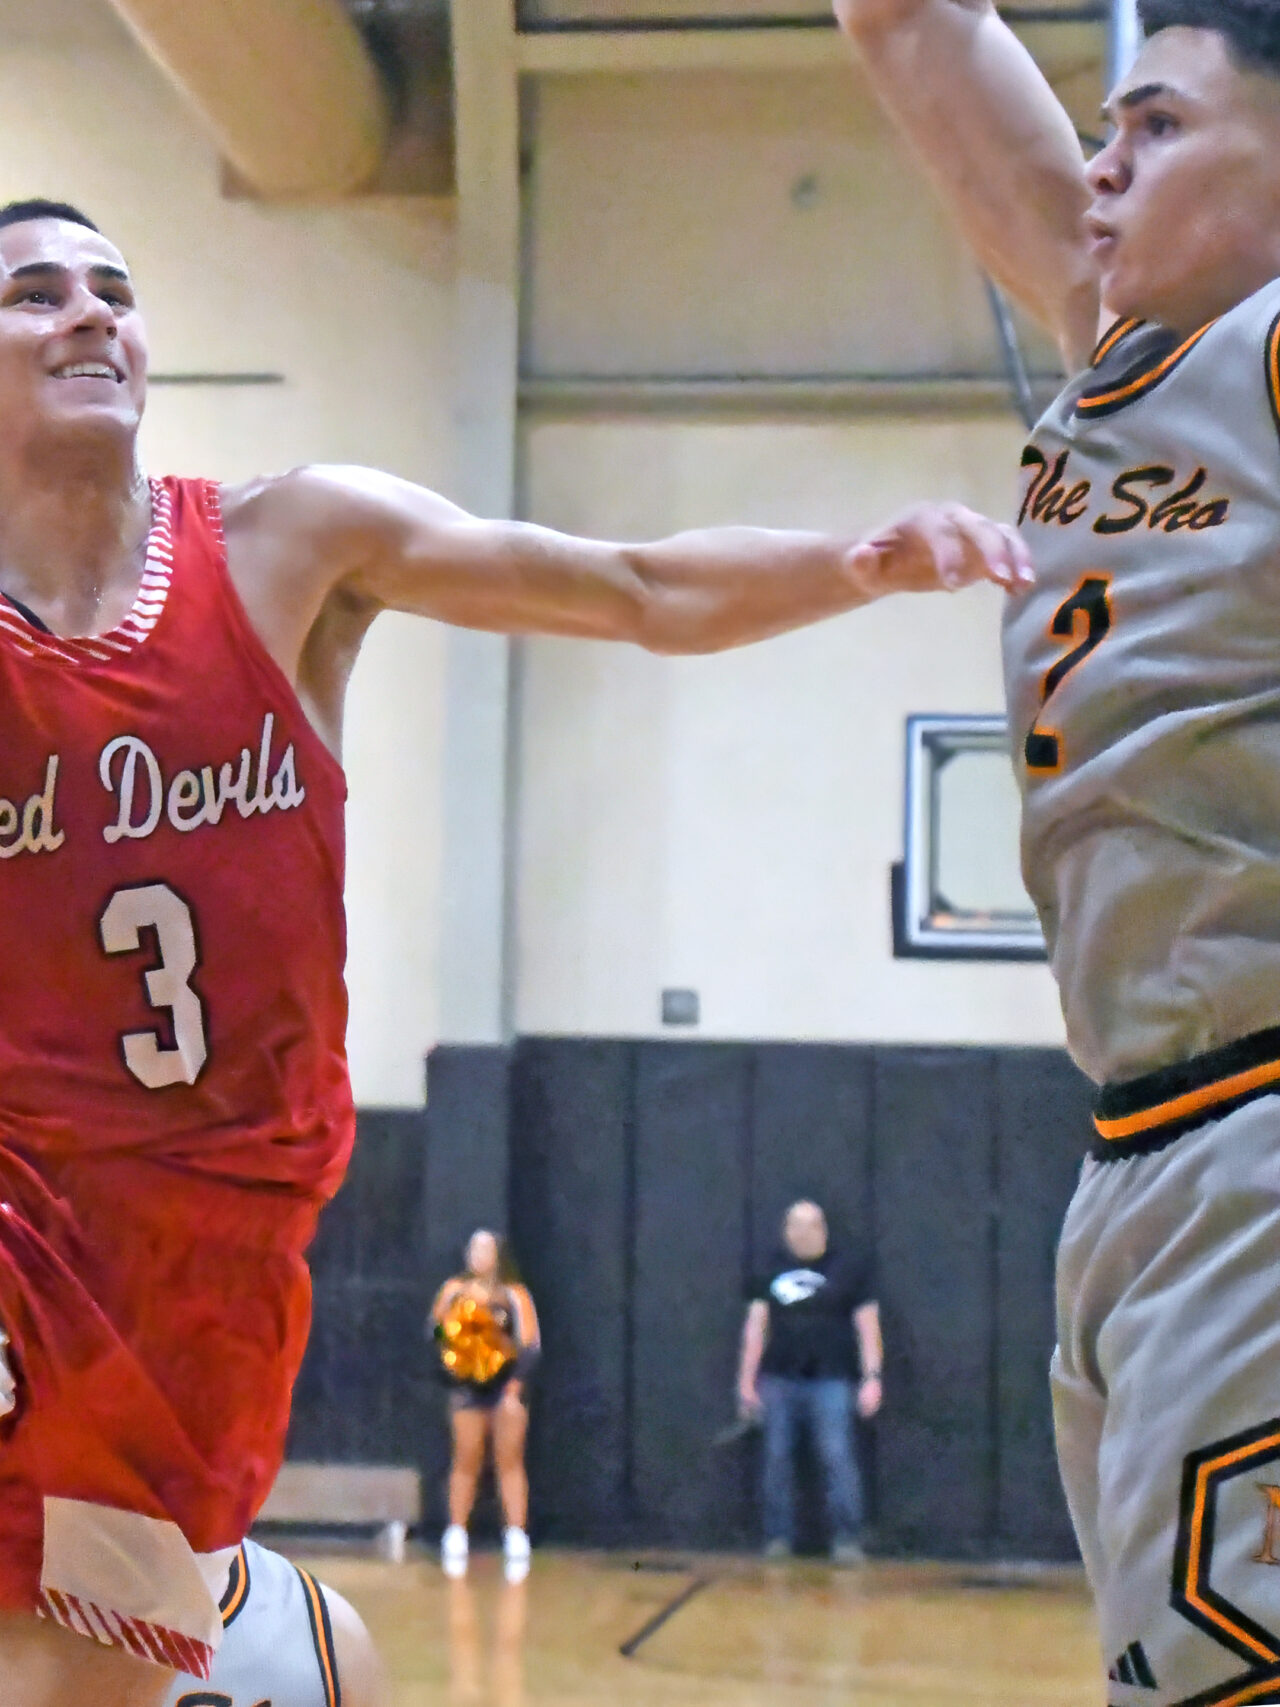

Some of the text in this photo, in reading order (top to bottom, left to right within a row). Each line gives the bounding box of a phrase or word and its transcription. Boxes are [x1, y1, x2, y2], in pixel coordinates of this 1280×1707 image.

[1018, 445, 1091, 526] The
[99, 711, 306, 845] Devils
[98, 880, 209, 1091] 3
